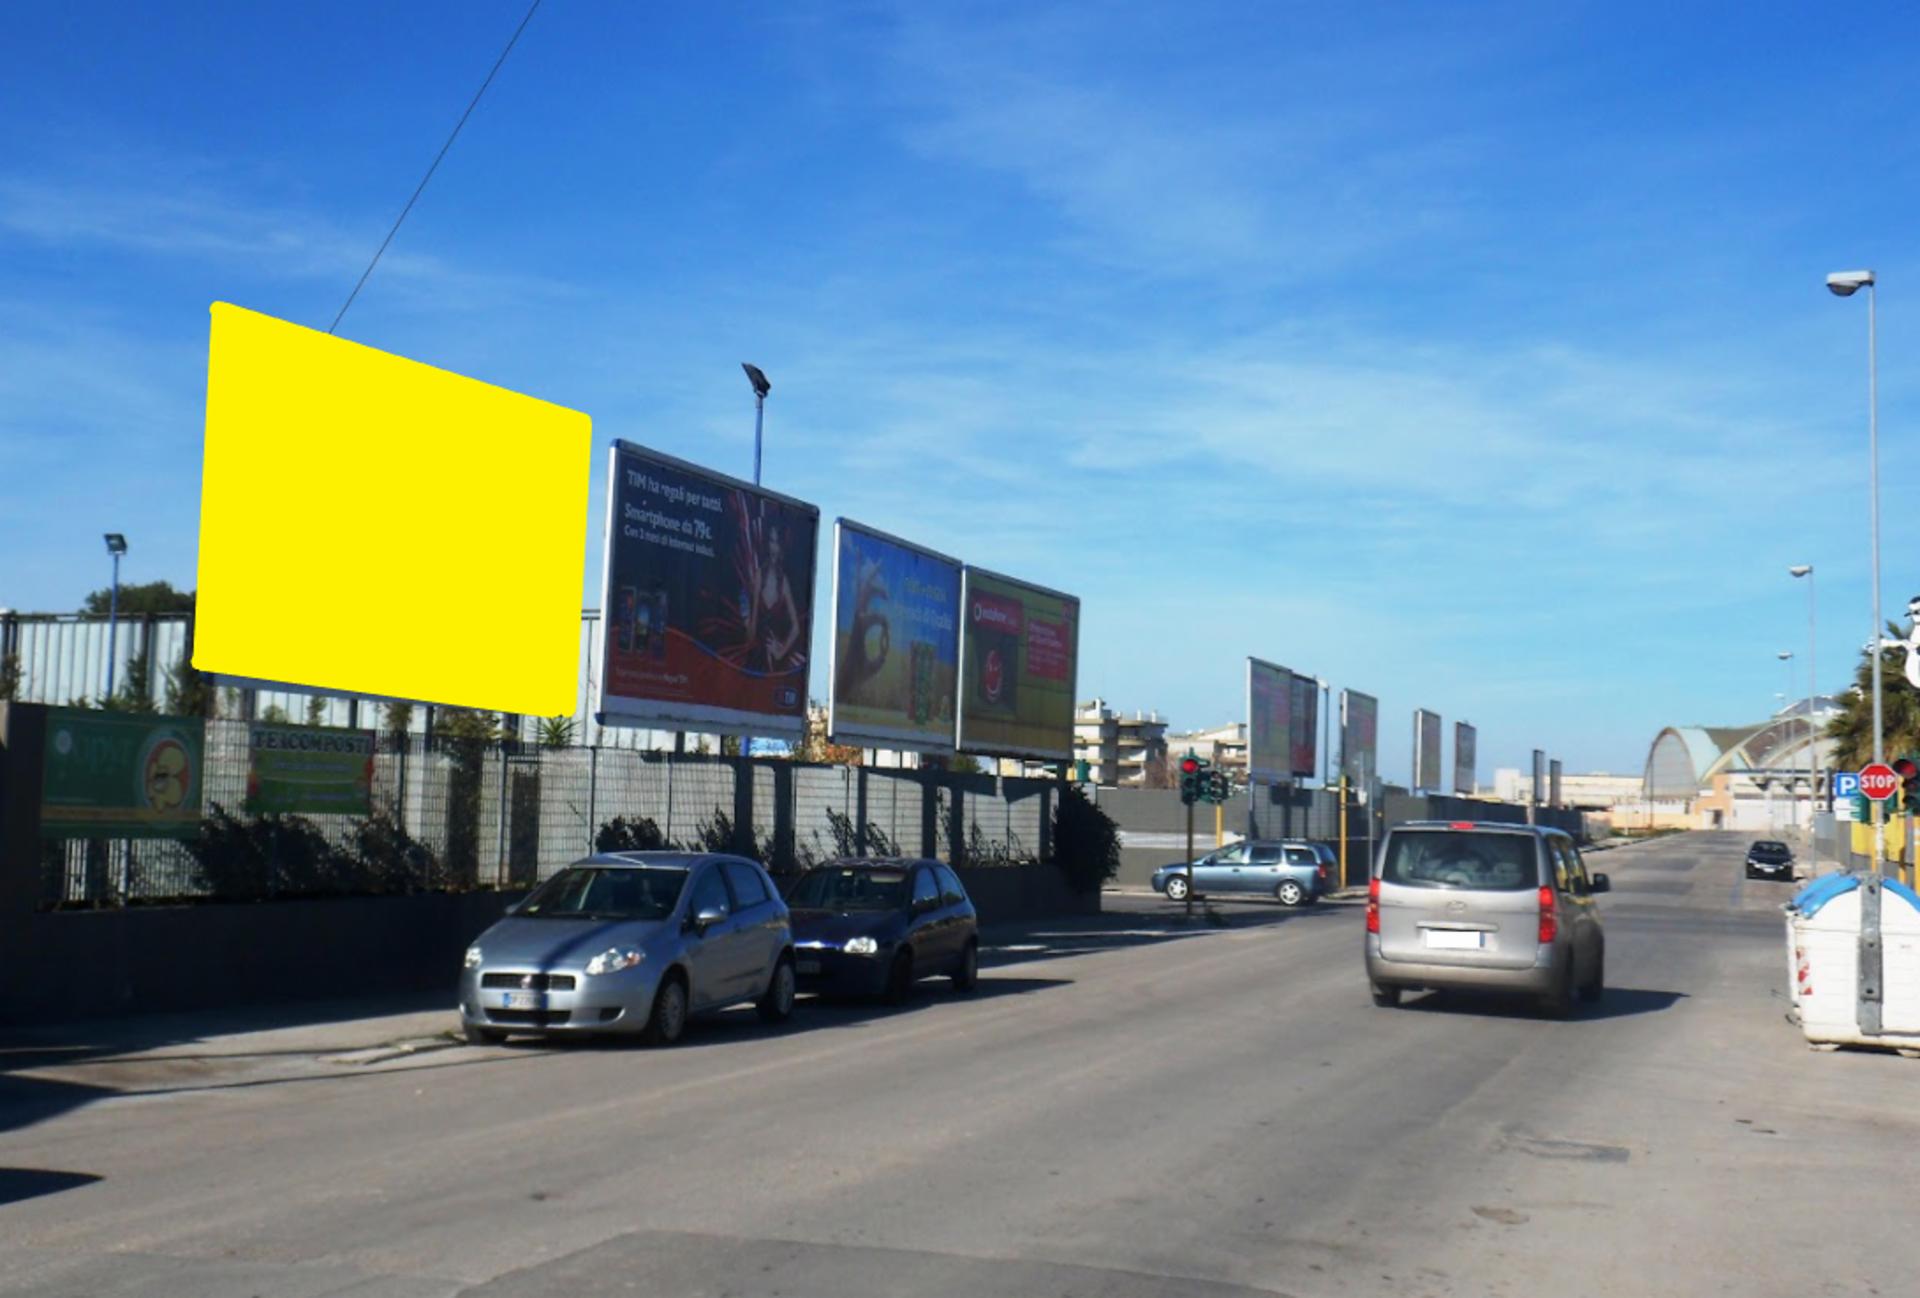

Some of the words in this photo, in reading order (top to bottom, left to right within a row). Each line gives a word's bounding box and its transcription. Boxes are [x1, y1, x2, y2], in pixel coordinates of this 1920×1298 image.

[627, 469, 647, 488] TIM
[647, 476, 660, 493] ha
[686, 491, 701, 508] per
[624, 502, 681, 531] Smartphone
[681, 518, 693, 535] da
[624, 524, 639, 538] Con
[1840, 776, 1857, 794] P
[1860, 775, 1896, 788] STOP
